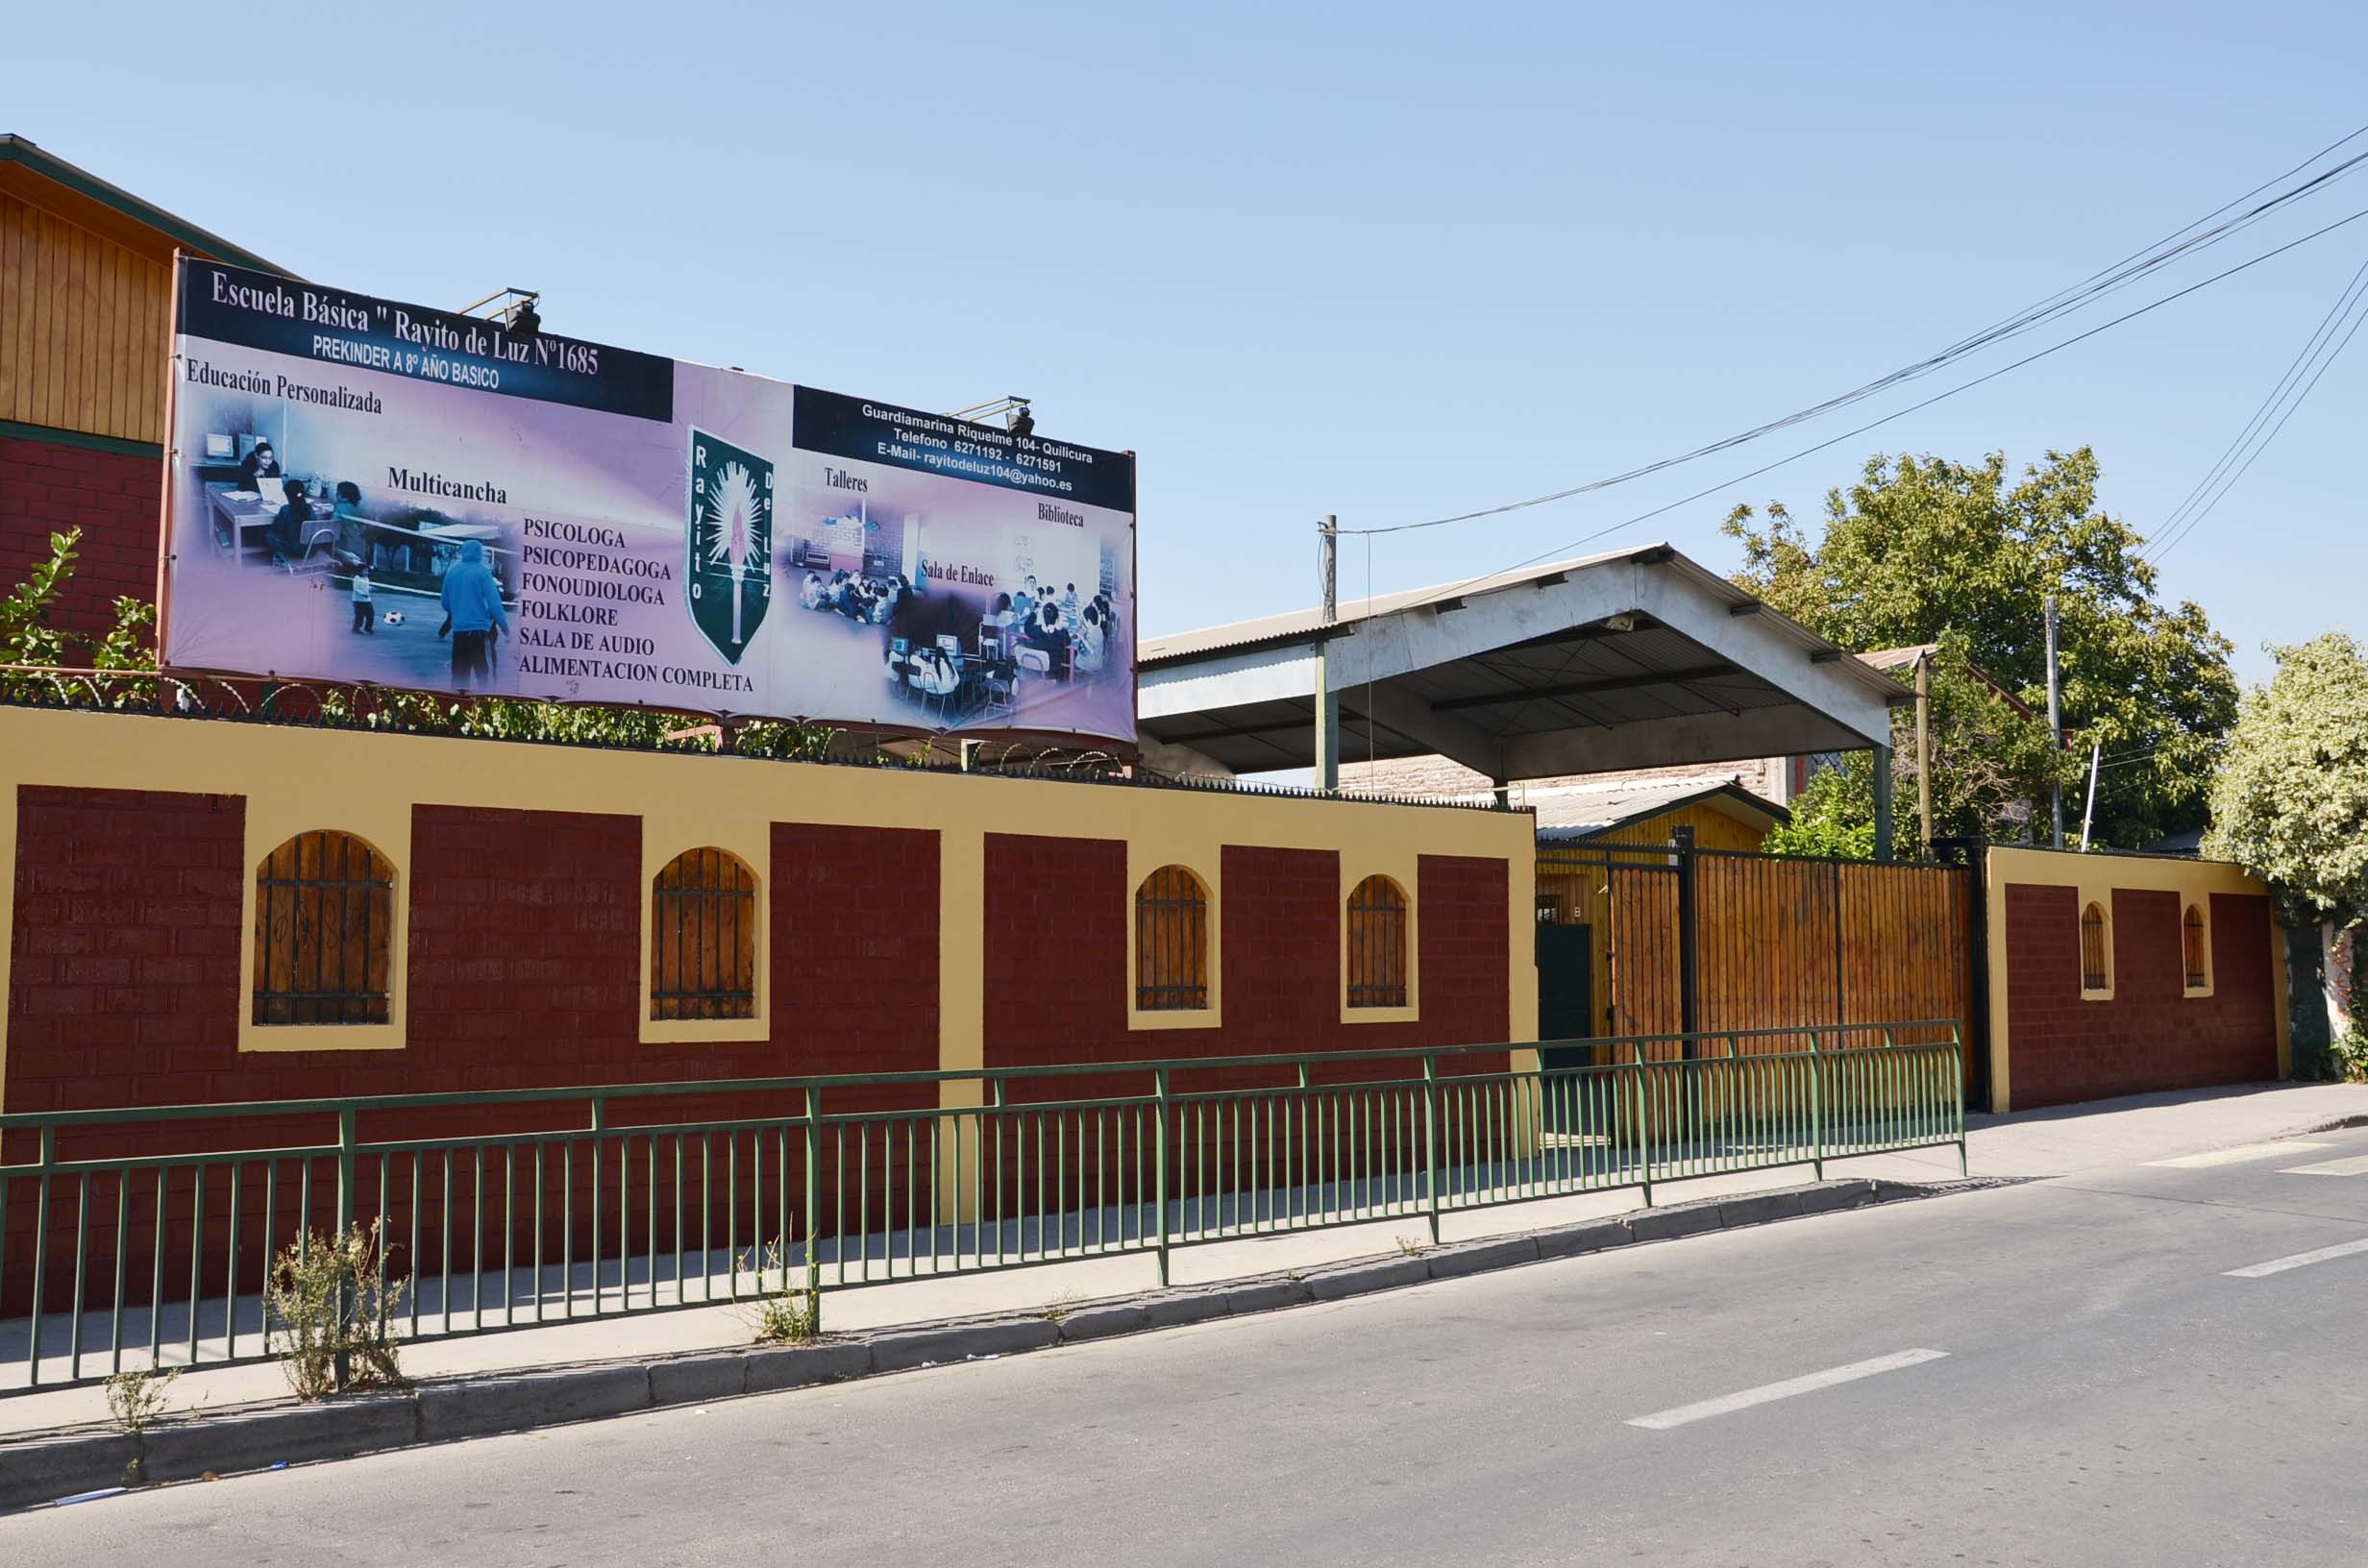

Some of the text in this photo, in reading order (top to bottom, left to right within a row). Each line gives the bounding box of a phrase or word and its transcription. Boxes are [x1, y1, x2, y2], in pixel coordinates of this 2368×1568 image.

[211, 271, 294, 317] Escuela
[303, 291, 369, 332] Básica
[395, 309, 458, 353] Rayito
[465, 328, 487, 355] de
[494, 331, 529, 363] Luz
[313, 334, 389, 369] PREKINDER
[393, 353, 403, 372] A
[421, 354, 449, 380] AÑO
[453, 367, 499, 389] BASICO
[187, 358, 382, 414] Educación Personalizada
[862, 404, 954, 434] Guardiamarina
[957, 425, 1013, 446] Riquelme
[1043, 442, 1093, 463] Quilicura
[894, 428, 948, 450] Telefono
[954, 441, 1002, 461] 6271192
[1016, 453, 1061, 473] 6271591
[387, 466, 507, 504] Multicancha
[825, 467, 868, 493] Talleres
[924, 453, 1073, 491] rayitodeluz104@yahoo.es
[1038, 502, 1084, 527] Biblioteca
[524, 518, 626, 548] PSICOLOGA
[523, 545, 672, 580] PSICOPEDAGOGA
[922, 559, 995, 587] Sala de Enlace
[522, 573, 665, 605] FONOUDIOLOGA
[521, 600, 618, 626] FOLKLORE
[519, 627, 654, 655] SALA DE AUDIO
[519, 655, 753, 692] ALIMENTACION COMPLETA
